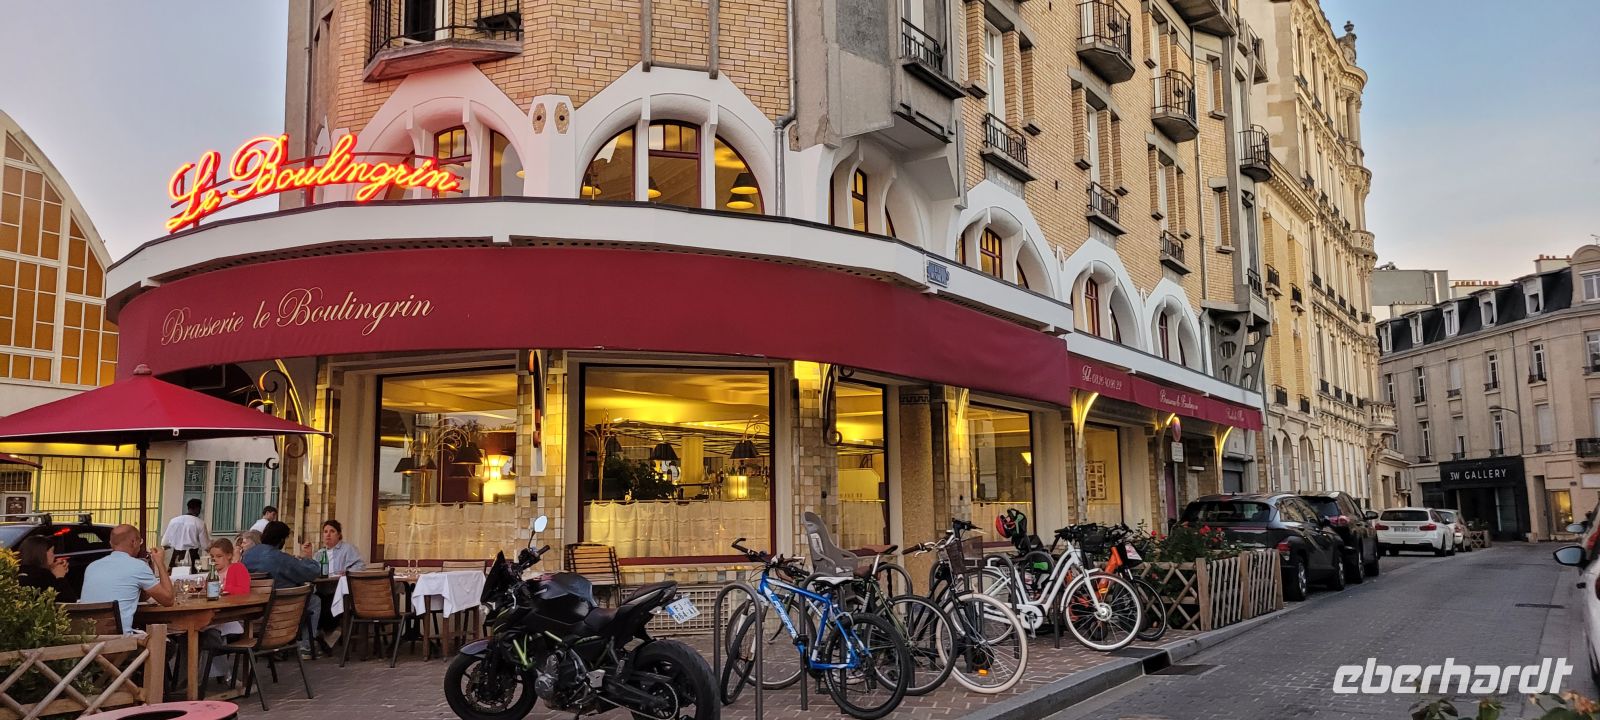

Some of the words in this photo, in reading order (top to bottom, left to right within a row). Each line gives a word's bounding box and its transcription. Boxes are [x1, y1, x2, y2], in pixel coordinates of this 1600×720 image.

[164, 150, 220, 234] Le
[226, 133, 461, 202] Boulingrin
[161, 306, 245, 346] Brasserie
[253, 300, 272, 330] le
[276, 286, 435, 336] Boulingrin
[1464, 468, 1507, 480] GALLERY
